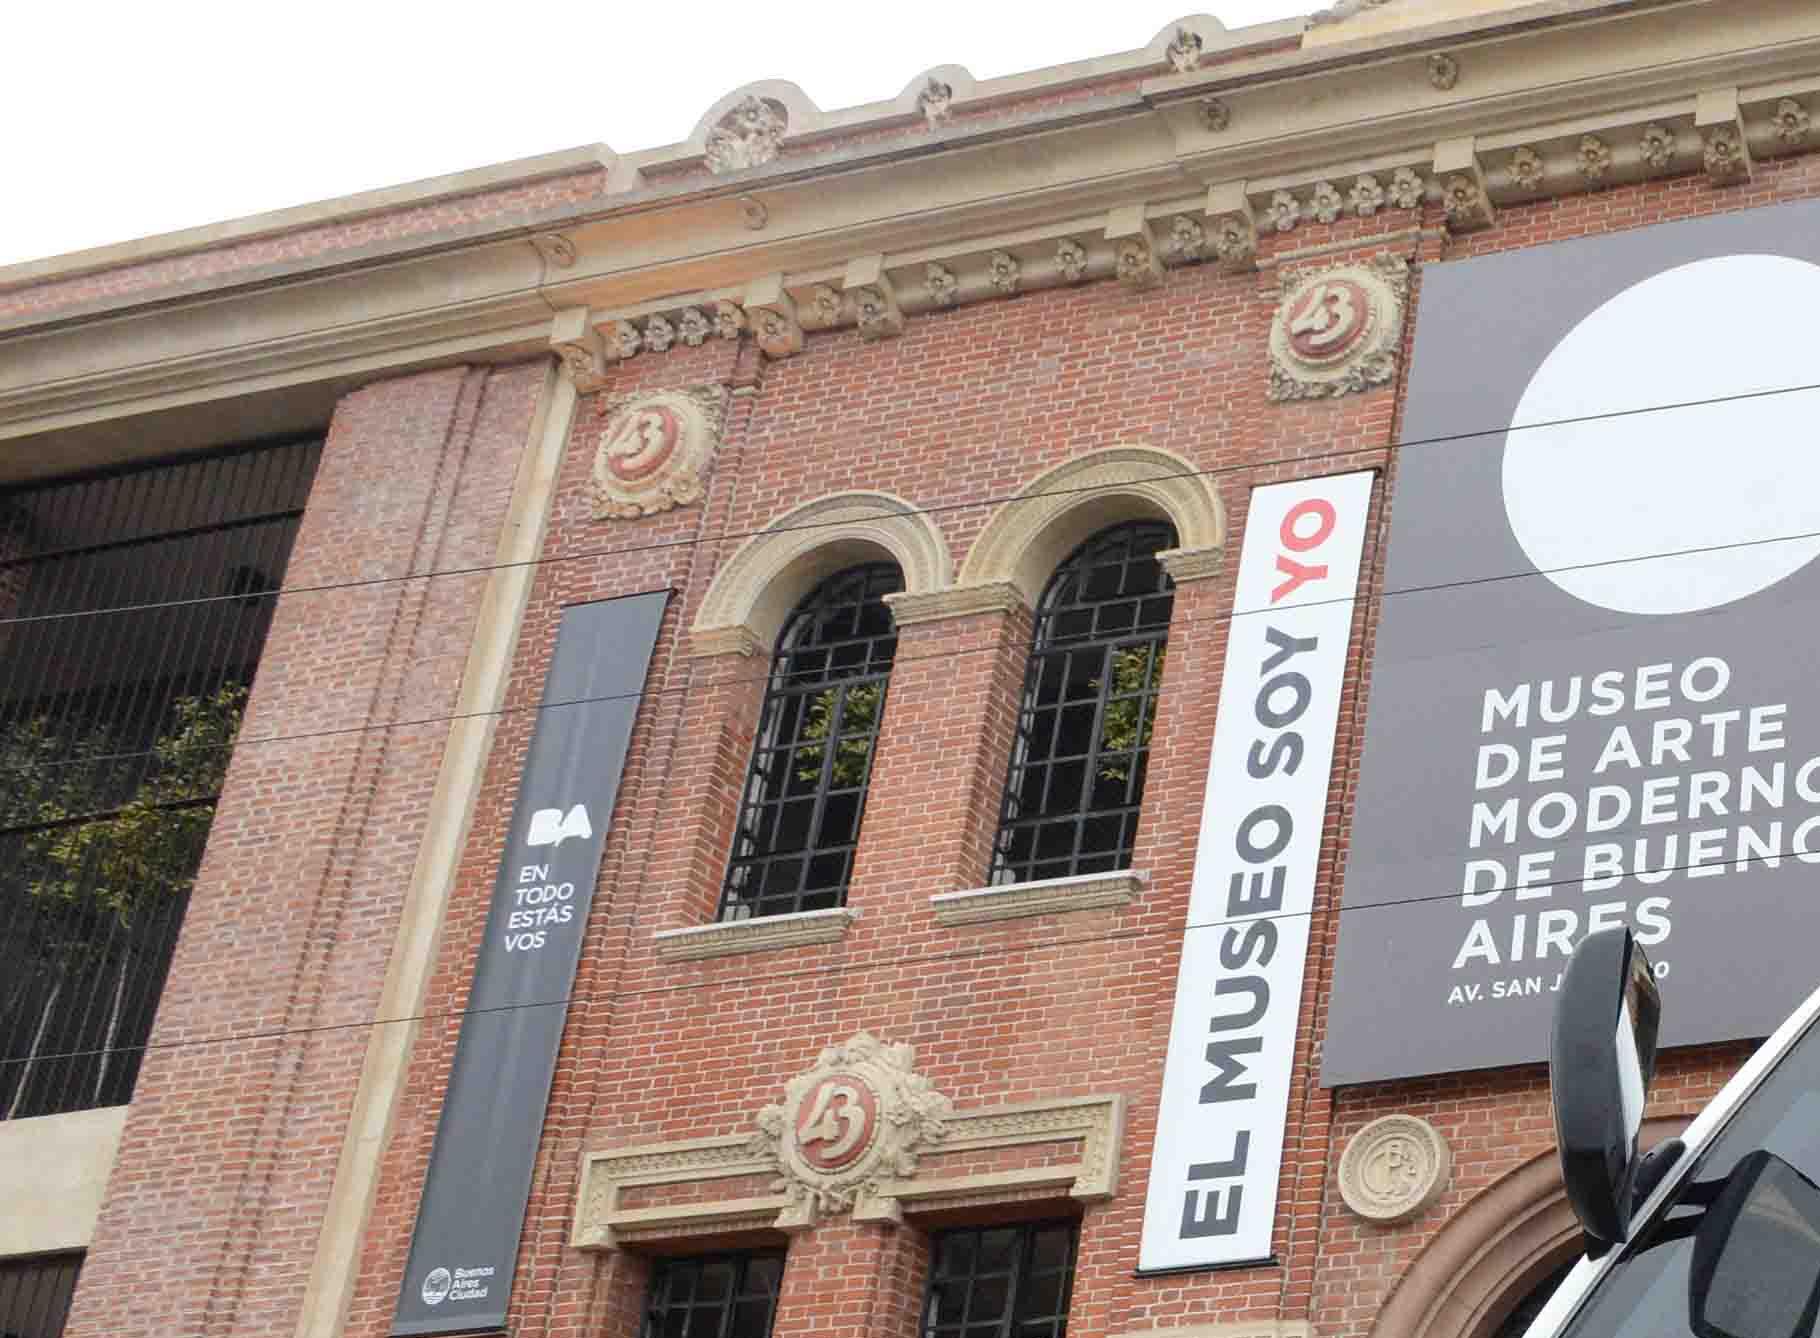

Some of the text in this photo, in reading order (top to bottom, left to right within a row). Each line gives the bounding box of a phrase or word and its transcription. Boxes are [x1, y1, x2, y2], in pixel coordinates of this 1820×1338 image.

[1481, 656, 1730, 733] MUSEO
[1475, 703, 1788, 790] DE ARTE
[519, 864, 549, 883] EN
[1179, 497, 1337, 1240] EL MUSEO SOY YO
[1461, 850, 1556, 907] DE
[515, 883, 575, 905] TODO
[508, 903, 574, 929] ESTÁS
[504, 931, 547, 953] VOS
[1448, 983, 1484, 1004] AV.
[1492, 976, 1542, 999] SAN
